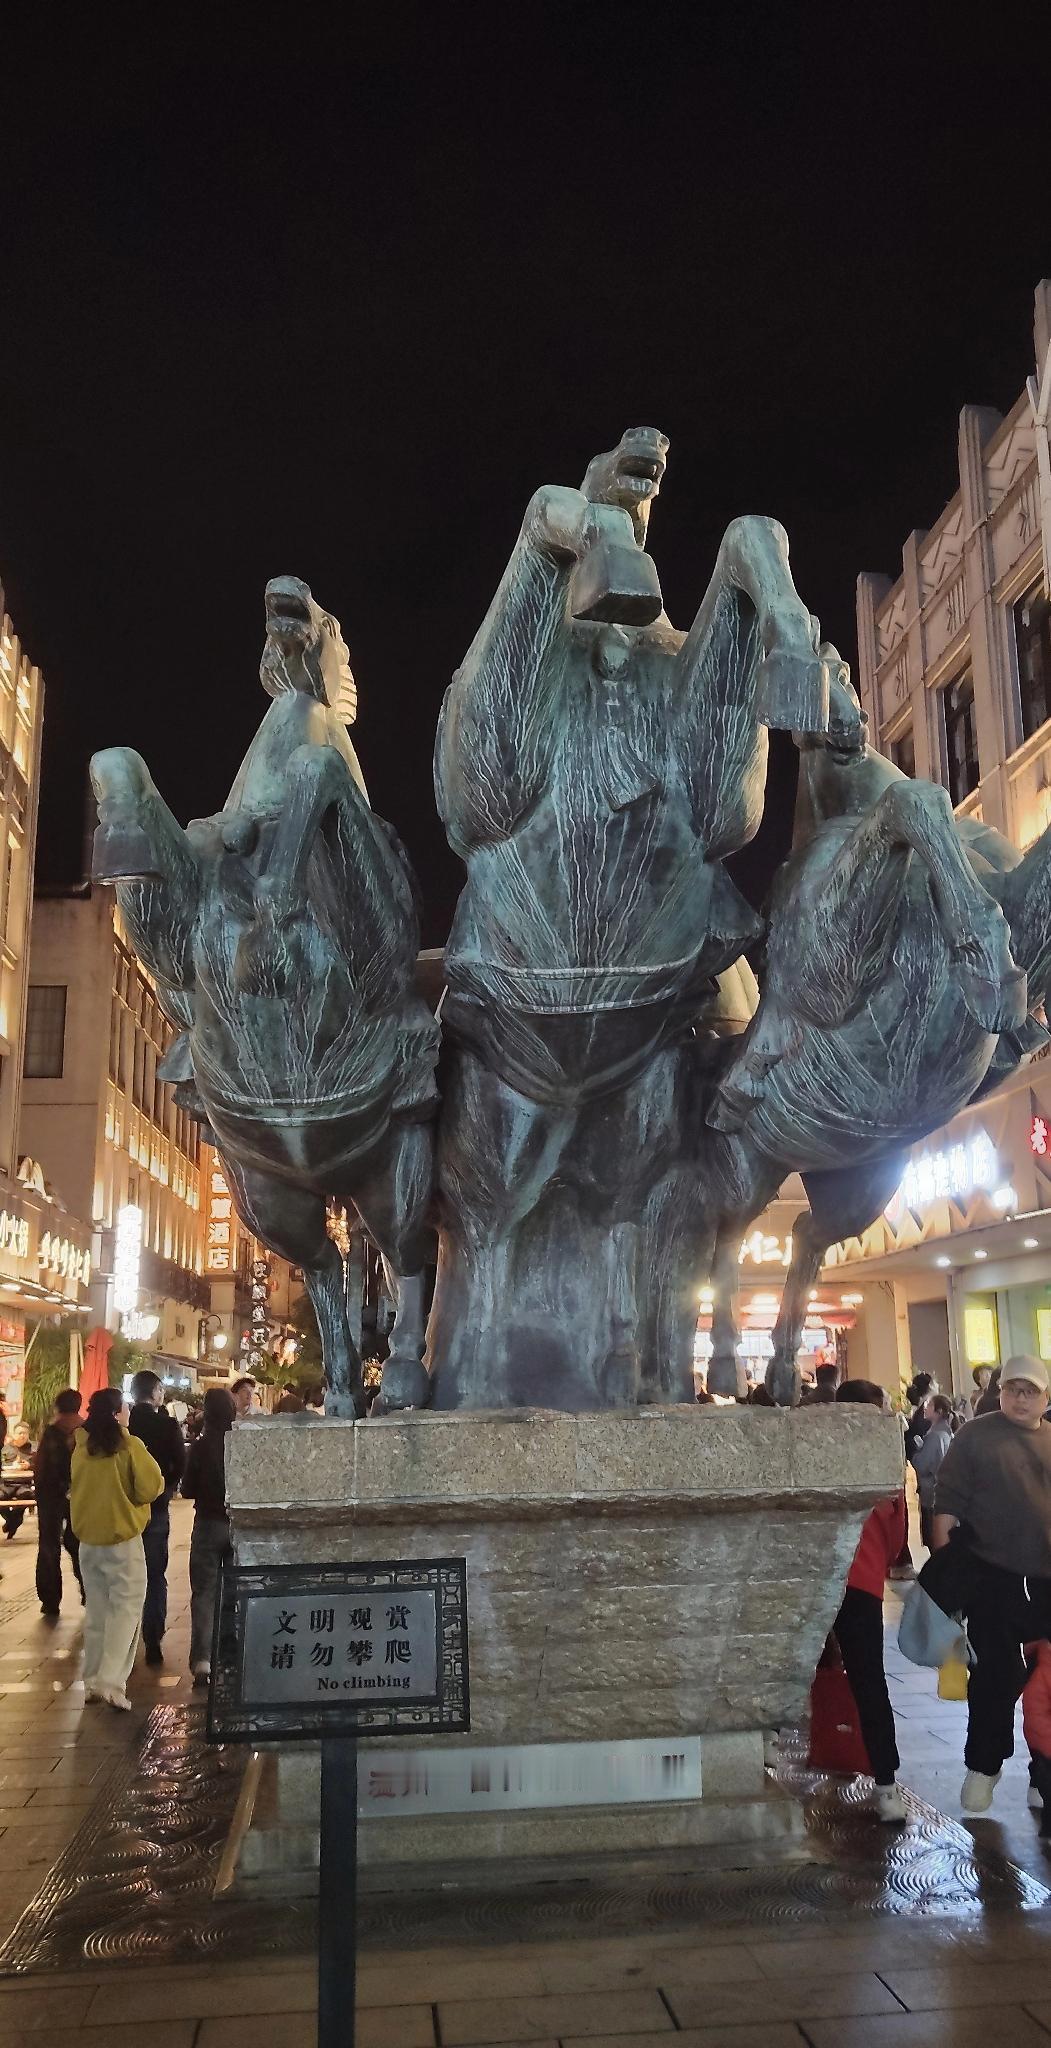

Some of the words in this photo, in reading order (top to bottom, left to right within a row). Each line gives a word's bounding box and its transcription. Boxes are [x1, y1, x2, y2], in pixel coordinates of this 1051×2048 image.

[272, 1605, 412, 1636] 文明观赏
[270, 1639, 413, 1670] 请勿攀爬
[317, 1677, 339, 1690] No
[342, 1674, 411, 1690] climbing
